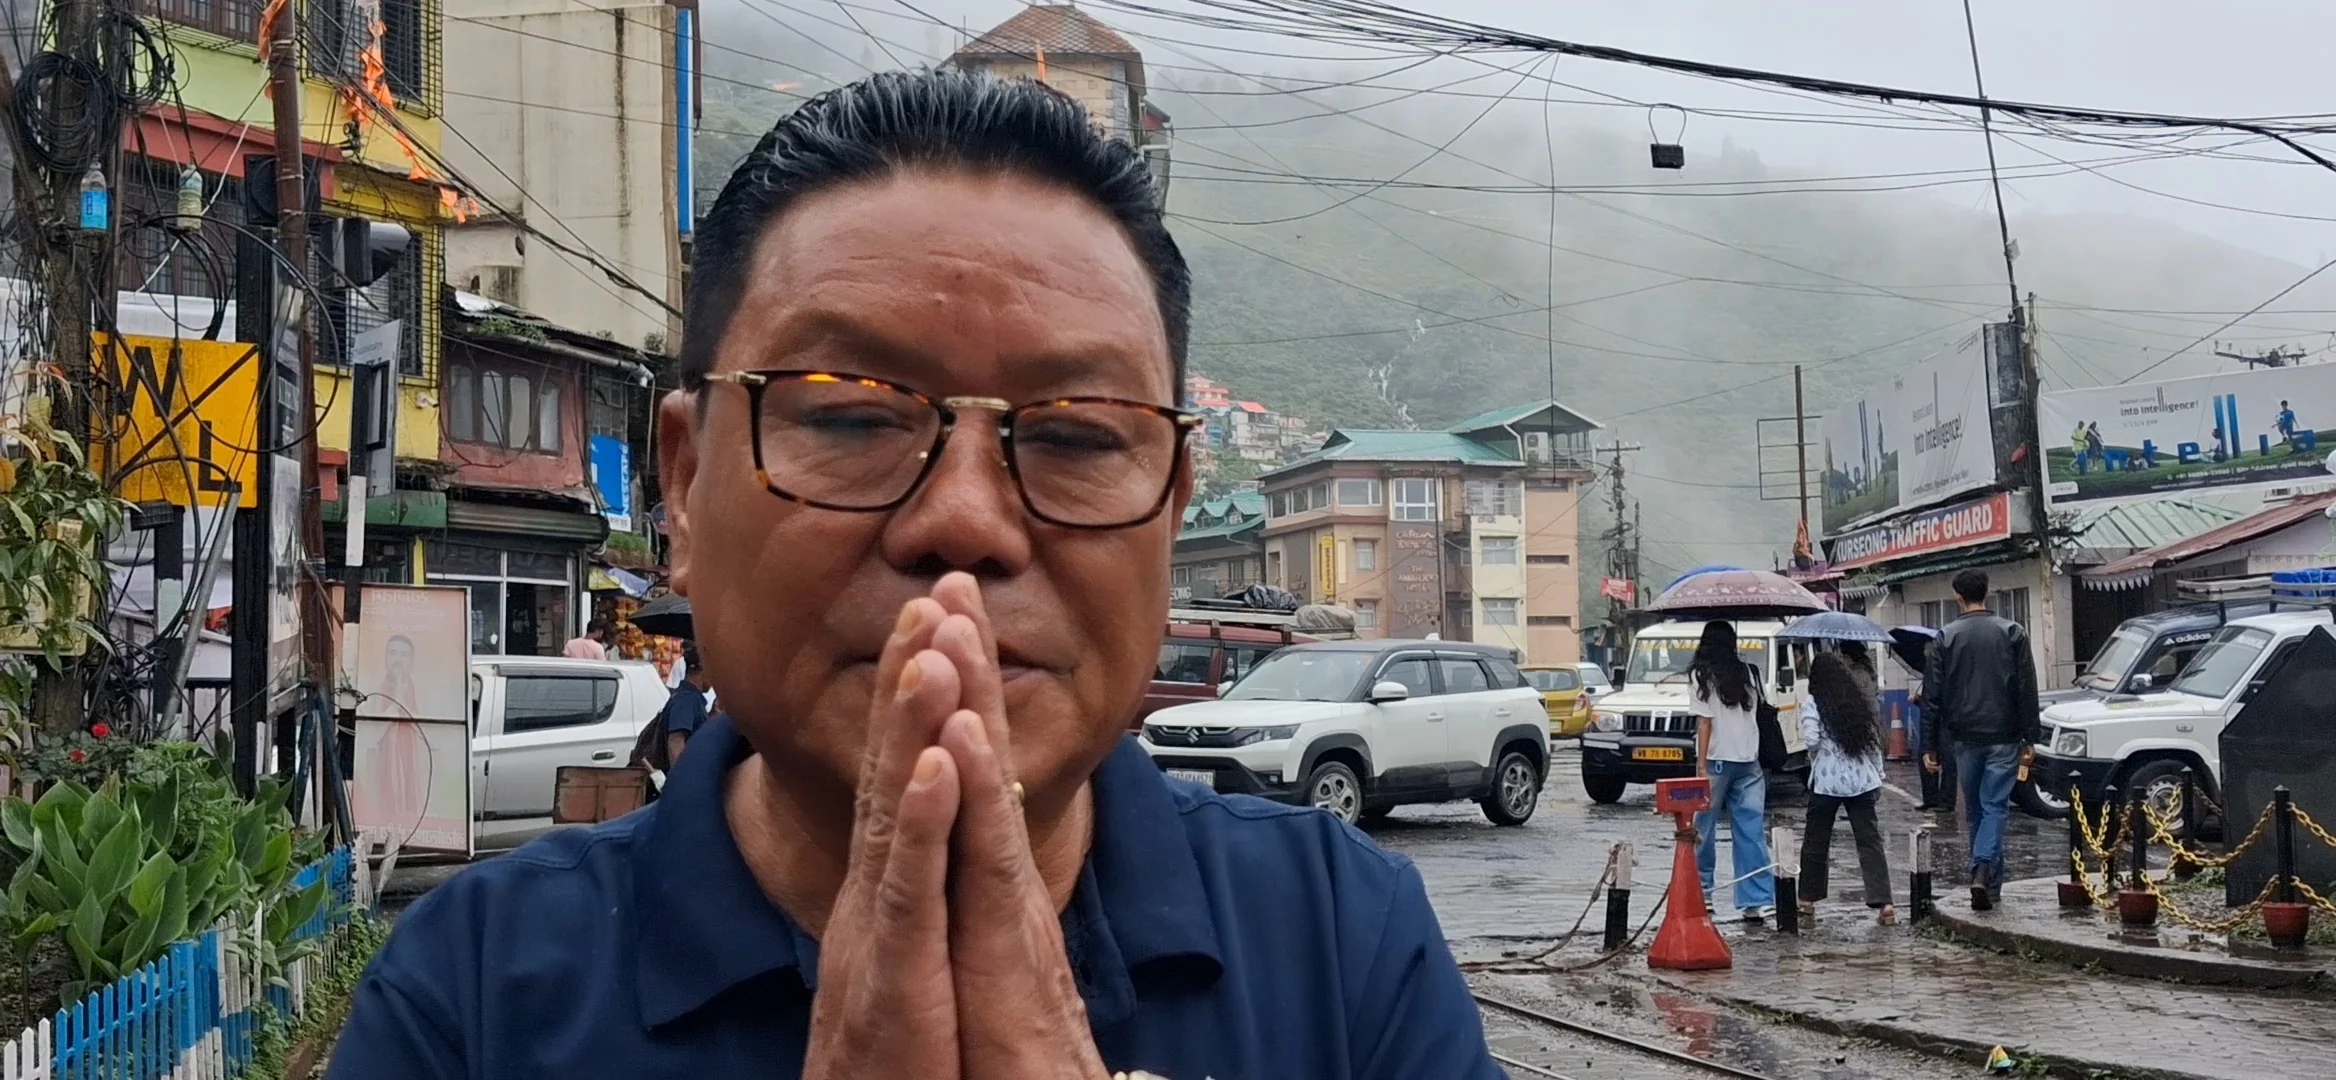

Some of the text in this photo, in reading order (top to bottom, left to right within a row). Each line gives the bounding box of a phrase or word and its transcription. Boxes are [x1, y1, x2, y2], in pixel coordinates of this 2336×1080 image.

[103, 343, 182, 417] W
[198, 420, 242, 493] L
[1835, 503, 1993, 563] KURSEONG TRAFFIC GUARD
[2175, 633, 2212, 643] adidas
